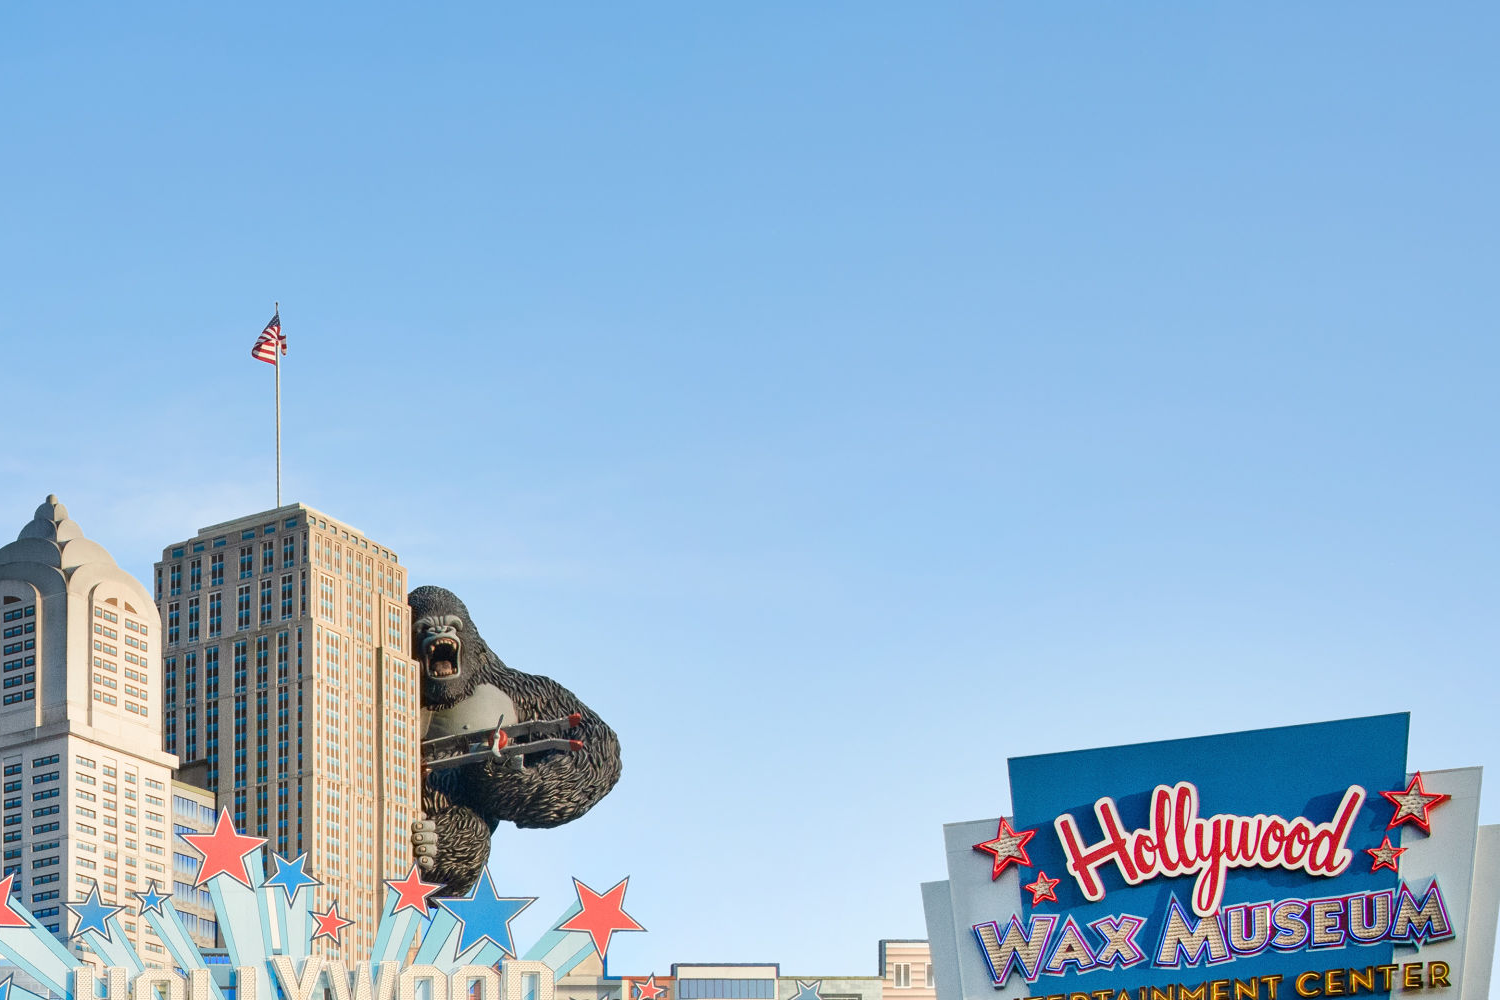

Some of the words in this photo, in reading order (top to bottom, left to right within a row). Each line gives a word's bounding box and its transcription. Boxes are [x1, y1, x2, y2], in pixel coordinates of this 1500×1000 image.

[1054, 781, 1366, 917] Hollywood
[972, 912, 1147, 988] WAX
[1151, 876, 1456, 968] MUSEUM
[1295, 960, 1451, 997] CENTER
